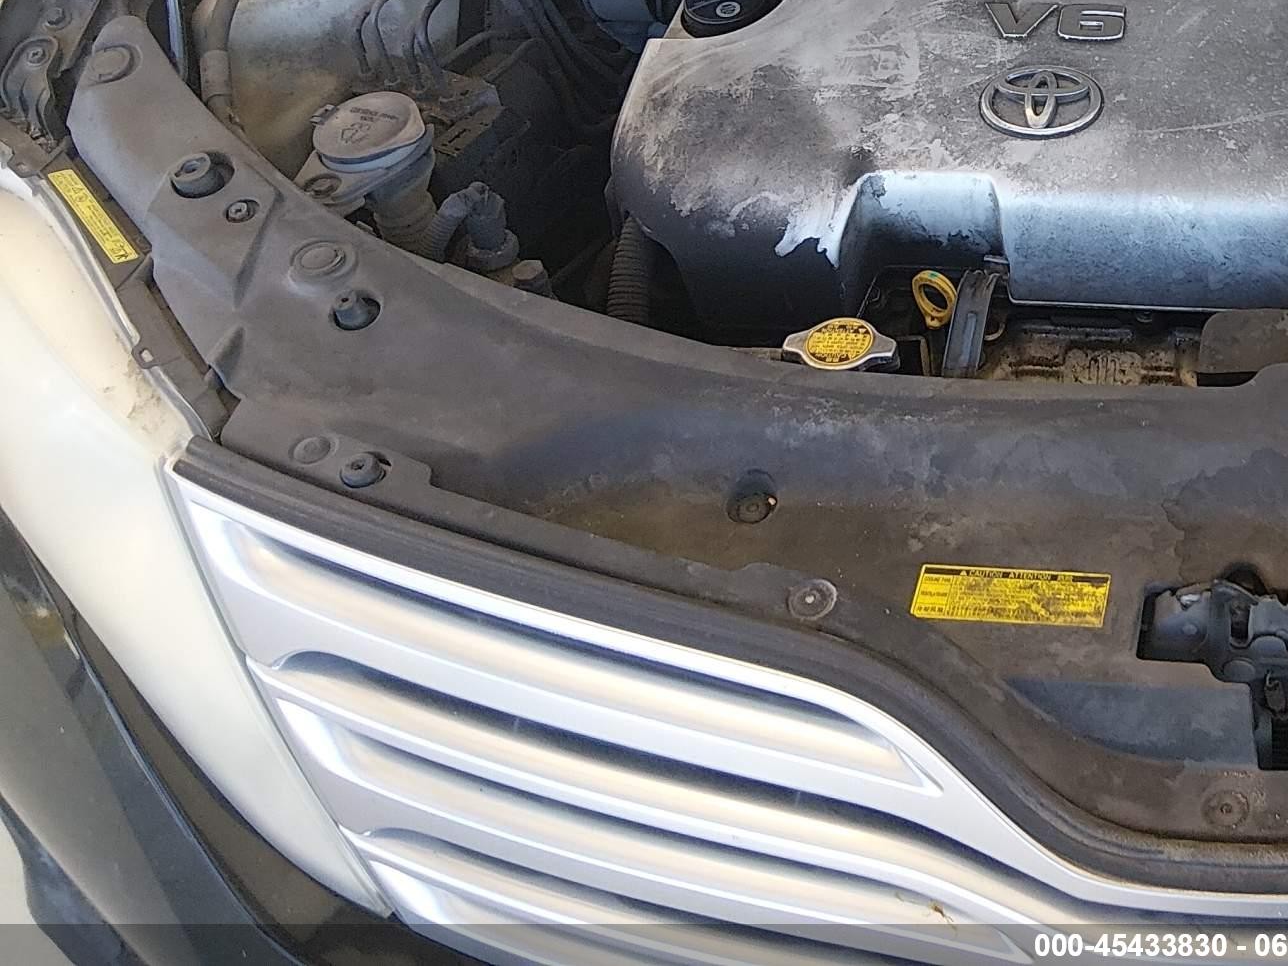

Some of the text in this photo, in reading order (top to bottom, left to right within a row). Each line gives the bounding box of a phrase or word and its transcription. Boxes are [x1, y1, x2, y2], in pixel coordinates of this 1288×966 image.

[985, 2, 1126, 40] V6
[969, 570, 1002, 578] CAUTION
[1009, 572, 1051, 581] ATTENTION
